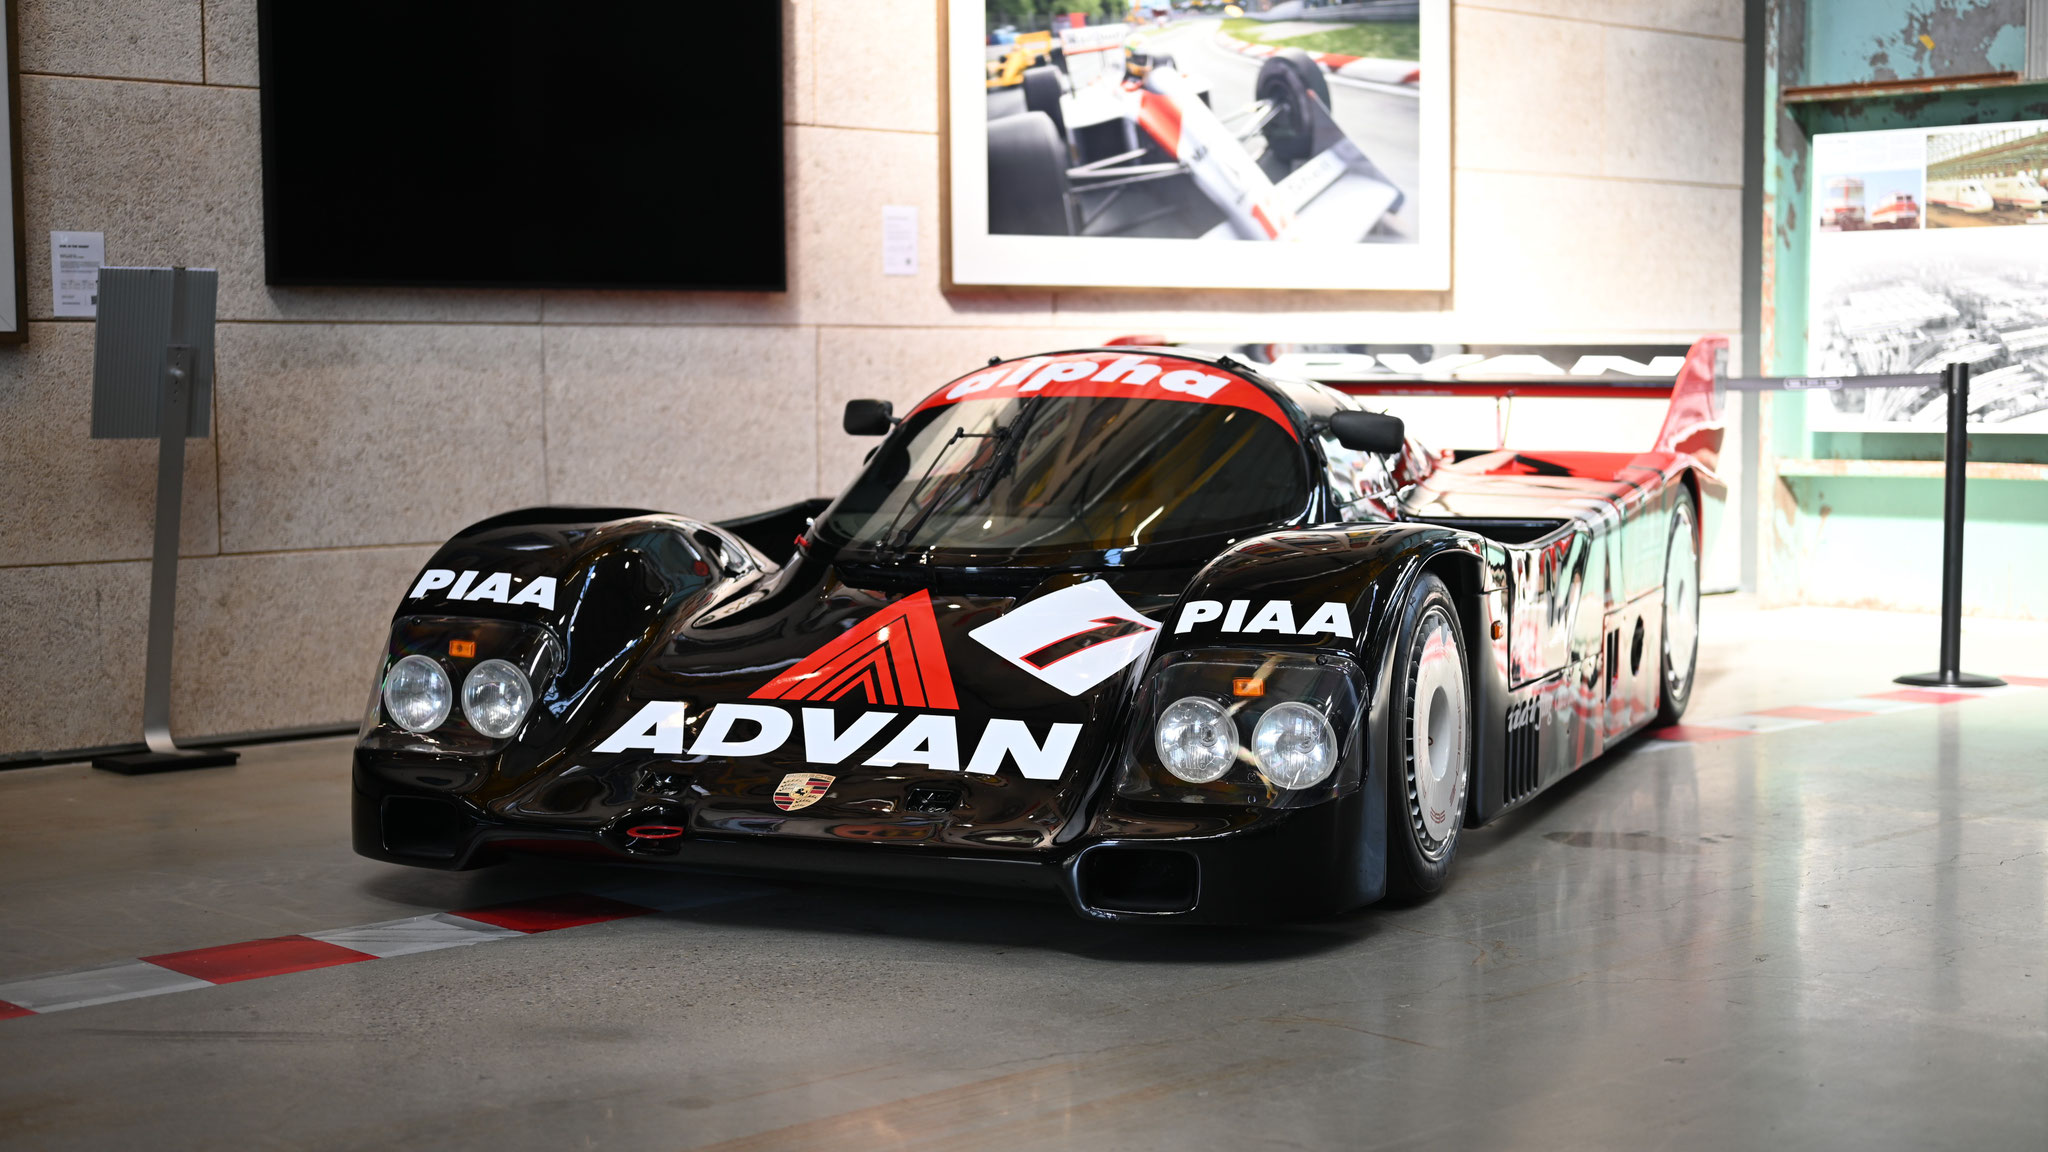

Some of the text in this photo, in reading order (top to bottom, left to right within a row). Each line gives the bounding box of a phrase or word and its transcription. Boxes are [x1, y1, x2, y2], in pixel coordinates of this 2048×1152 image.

[946, 355, 1231, 399] alpha
[410, 569, 557, 610] PIAA
[1174, 599, 1354, 639] PIAA
[592, 701, 1084, 781] ADVAN
